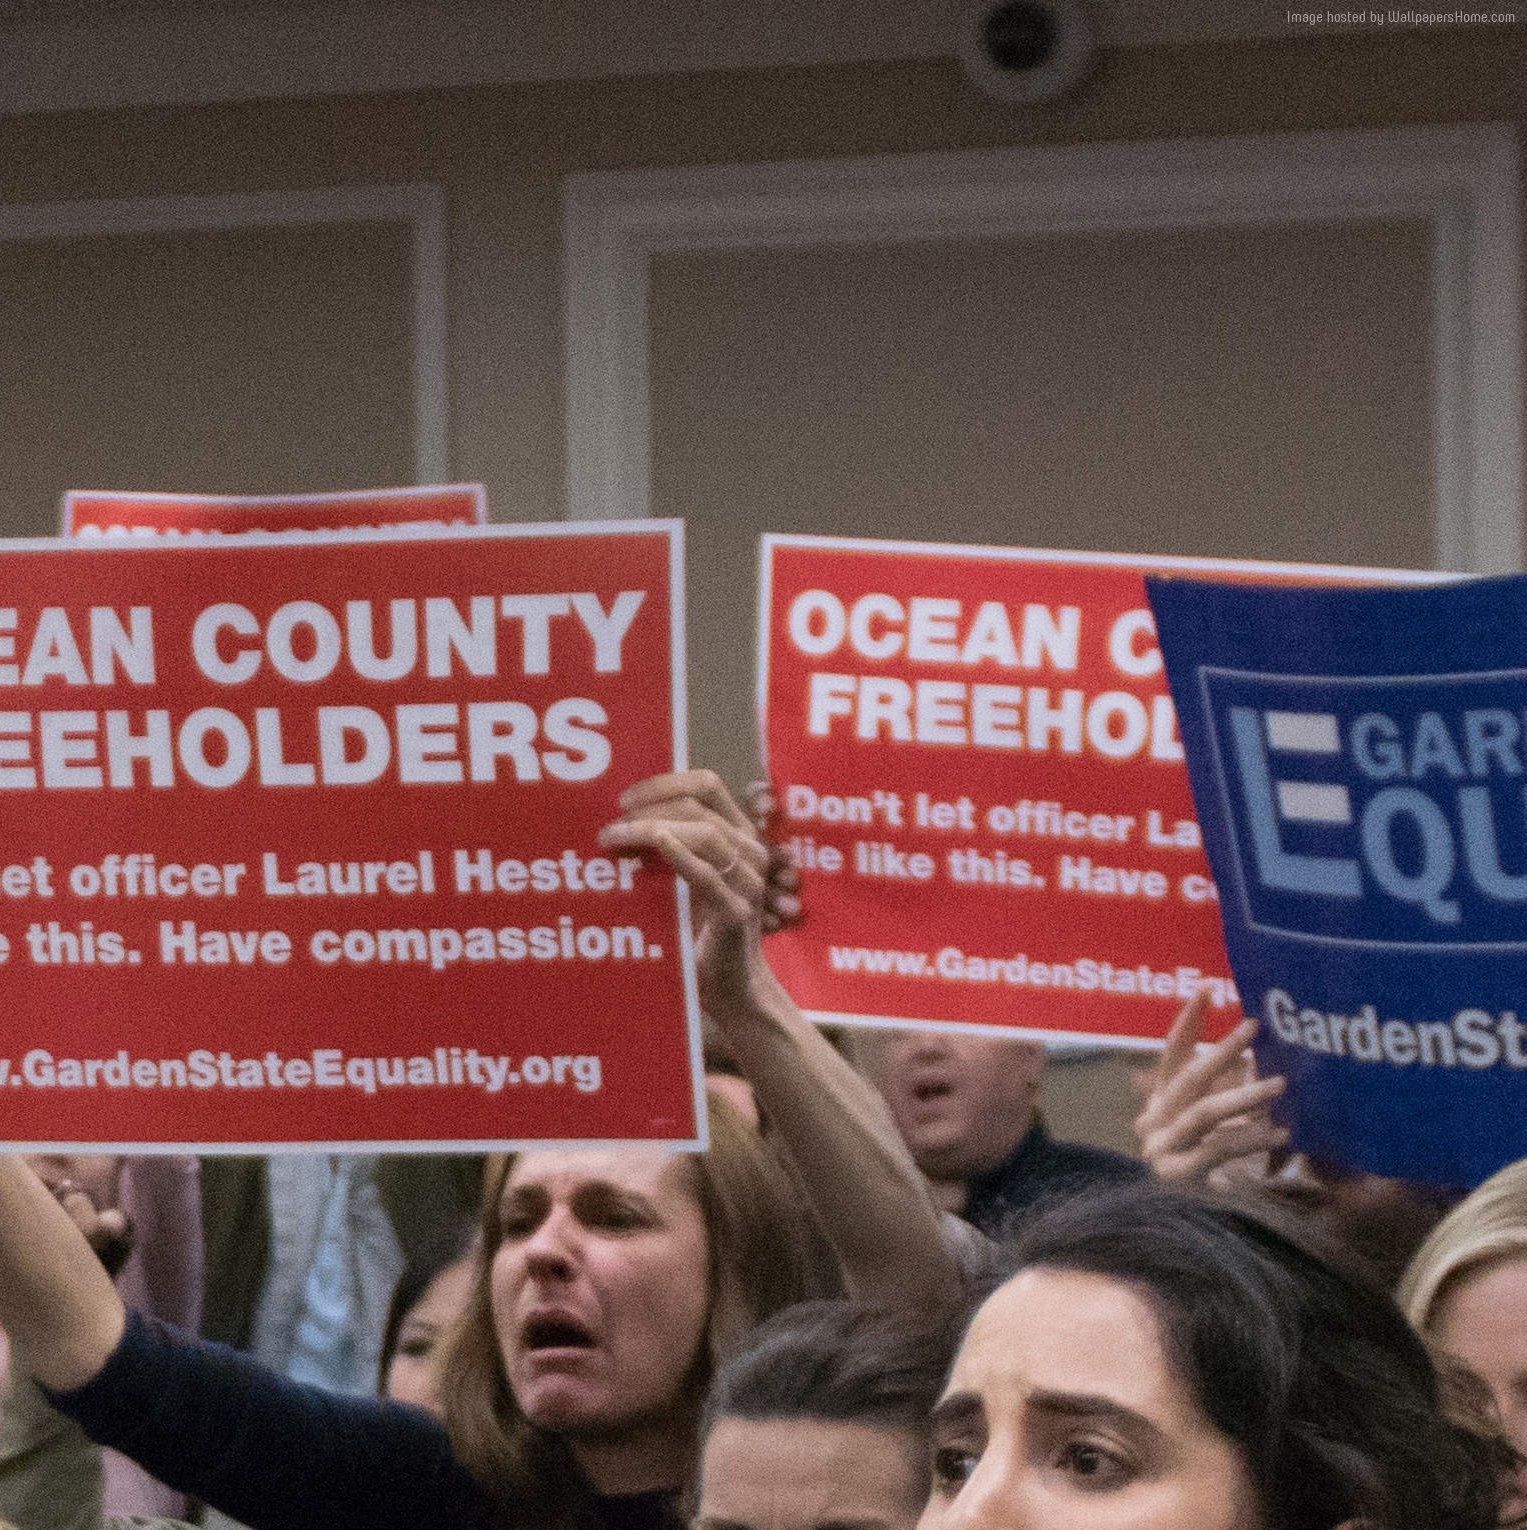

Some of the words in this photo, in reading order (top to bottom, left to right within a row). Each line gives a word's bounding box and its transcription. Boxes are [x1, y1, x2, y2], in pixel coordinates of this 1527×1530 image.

[190, 590, 647, 686] COUNTY
[788, 588, 1081, 671] OCEAN
[784, 785, 904, 827] Don't
[915, 792, 975, 831] let
[987, 800, 1135, 843] officer
[69, 852, 246, 898] officer
[264, 850, 434, 896] Laurel
[455, 846, 640, 894] Hester
[855, 840, 935, 880] like
[948, 849, 1045, 889] this.
[1058, 855, 1167, 900] Have
[25, 920, 142, 964] this.
[159, 920, 291, 964] Have
[309, 917, 662, 969] compassion.
